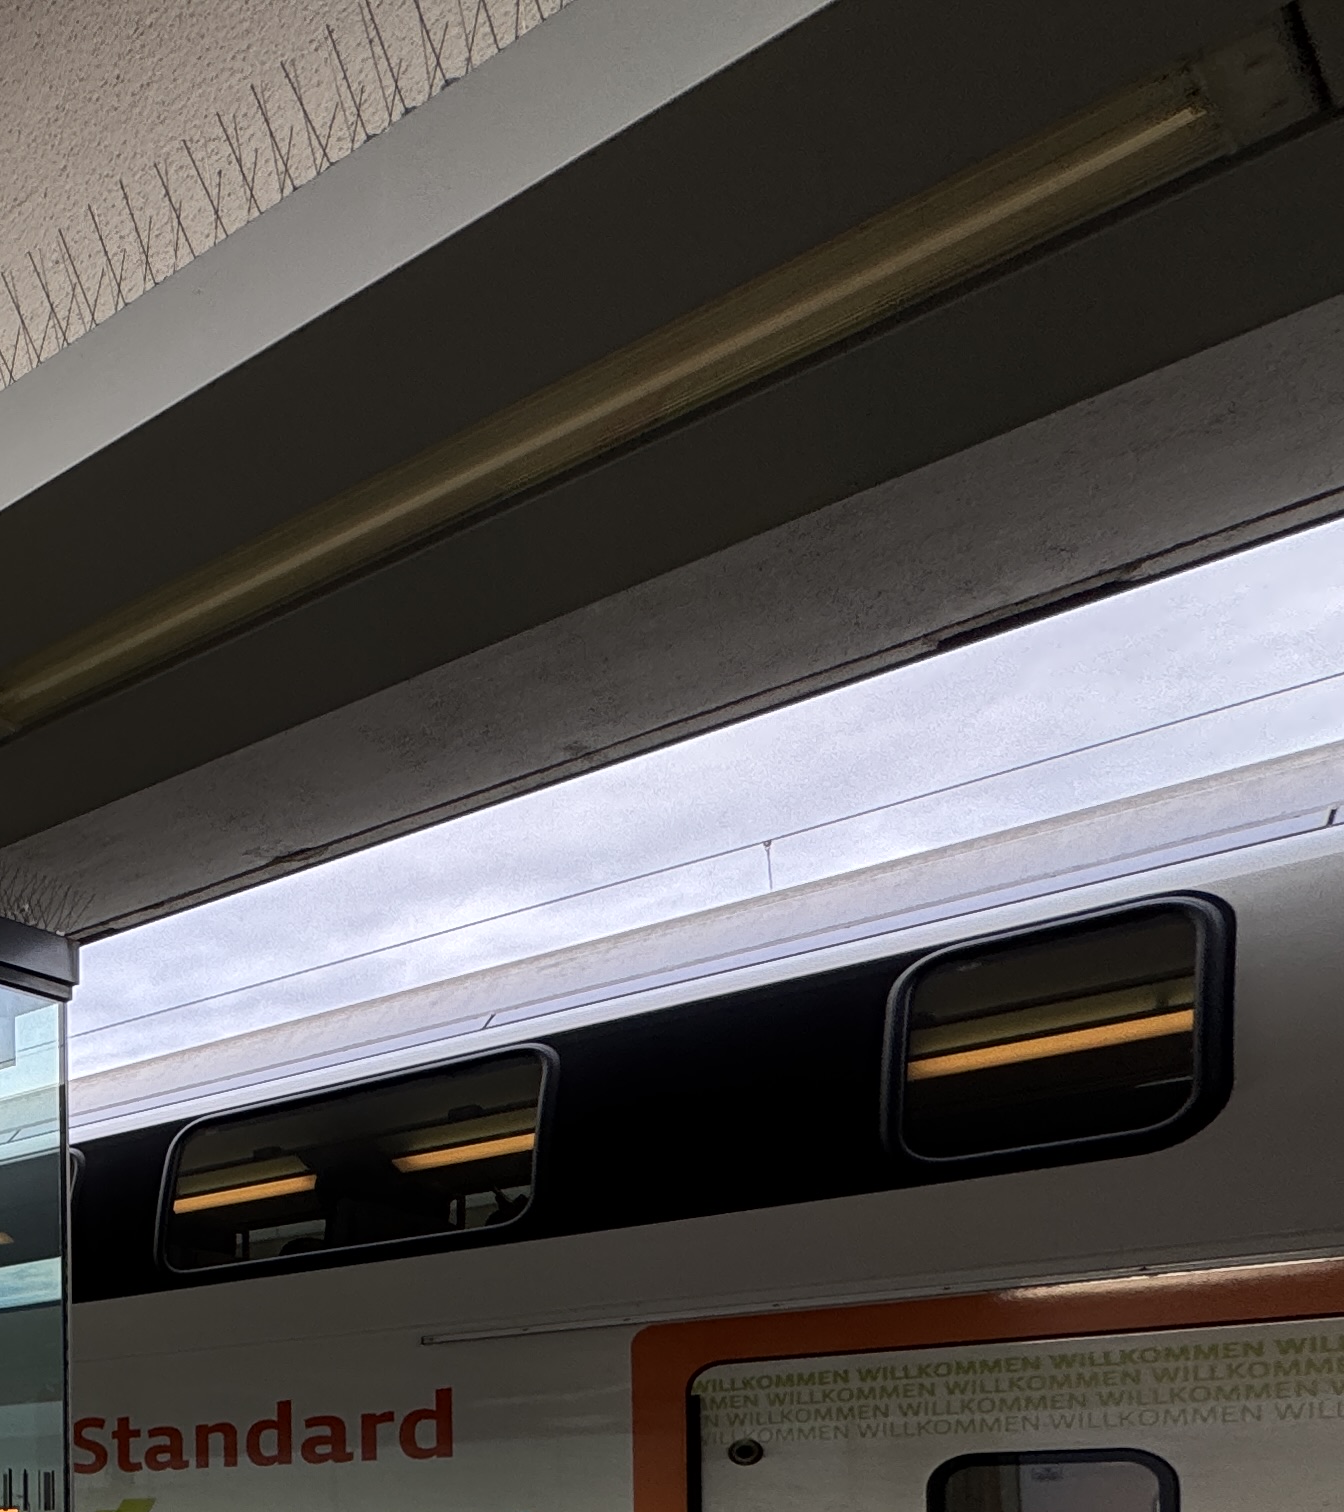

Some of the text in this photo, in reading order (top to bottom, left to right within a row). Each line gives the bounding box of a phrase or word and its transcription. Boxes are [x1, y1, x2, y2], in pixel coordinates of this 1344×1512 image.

[858, 1356, 1041, 1383] WILLKOMMEN
[1048, 1340, 1266, 1370] WILLKOMMEN
[727, 1401, 890, 1428] WILLKOMMEN
[898, 1389, 1087, 1417] WILLKOMMEN
[1098, 1379, 1318, 1408] WILLKOMMEN
[767, 1382, 937, 1408] WILLKOMMEN
[947, 1368, 1141, 1397] WILLKOMMEN
[73, 1387, 454, 1475] Standard
[857, 1414, 1040, 1440] WILLKOMMEN
[1051, 1403, 1263, 1430] WILLKOMMEN
